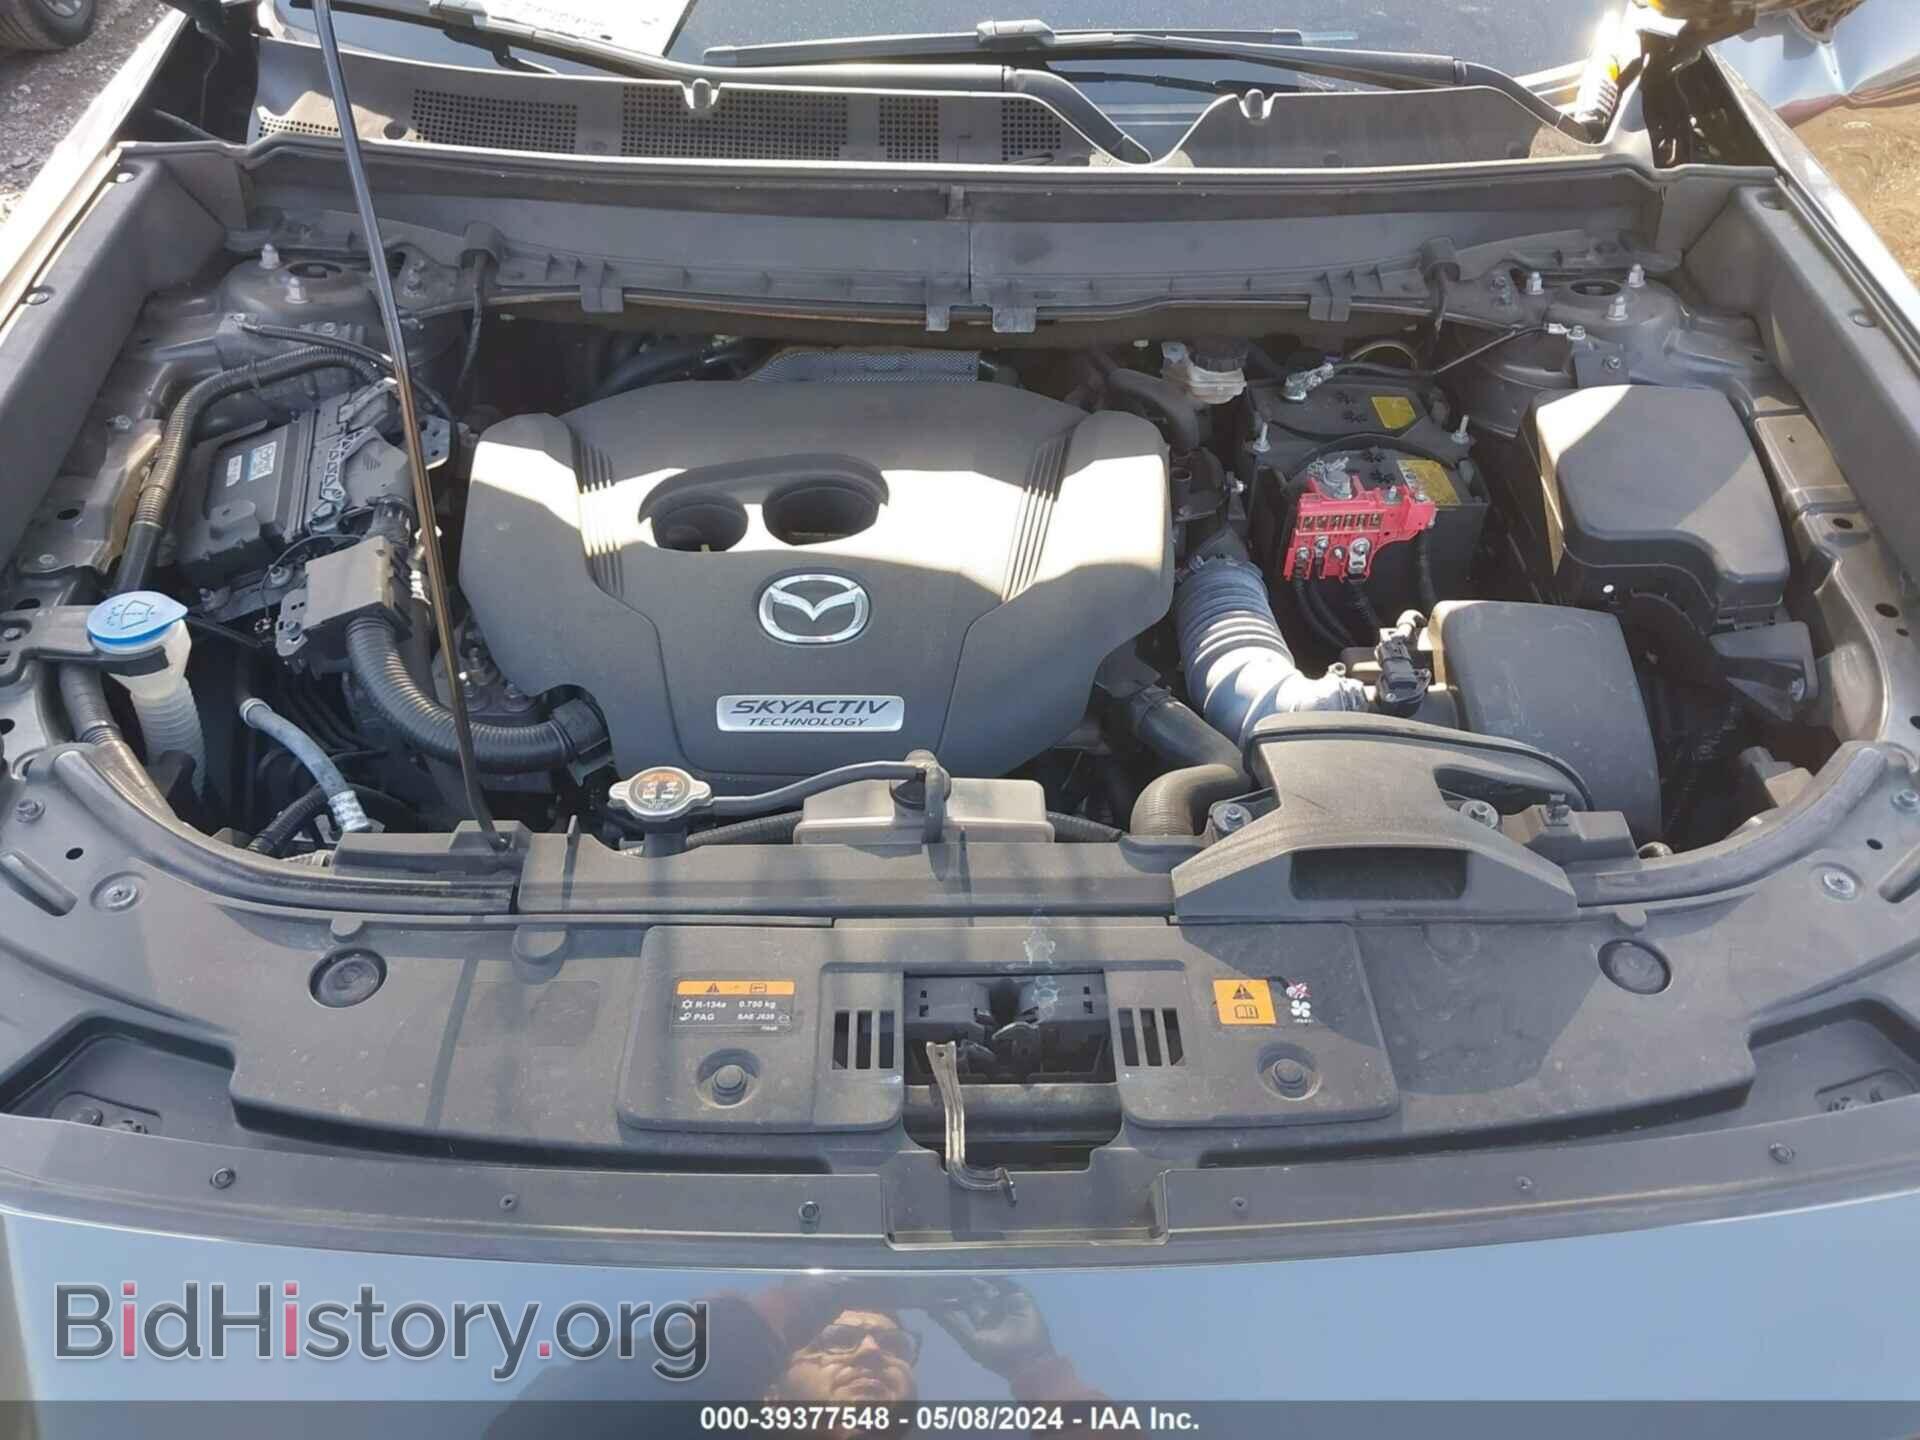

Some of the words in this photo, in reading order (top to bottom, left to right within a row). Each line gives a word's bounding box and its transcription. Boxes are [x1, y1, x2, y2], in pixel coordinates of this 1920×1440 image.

[730, 699, 891, 715] SKYACTIV
[749, 717, 869, 727] TECHNOLOGY
[692, 1013, 715, 1021] PAG
